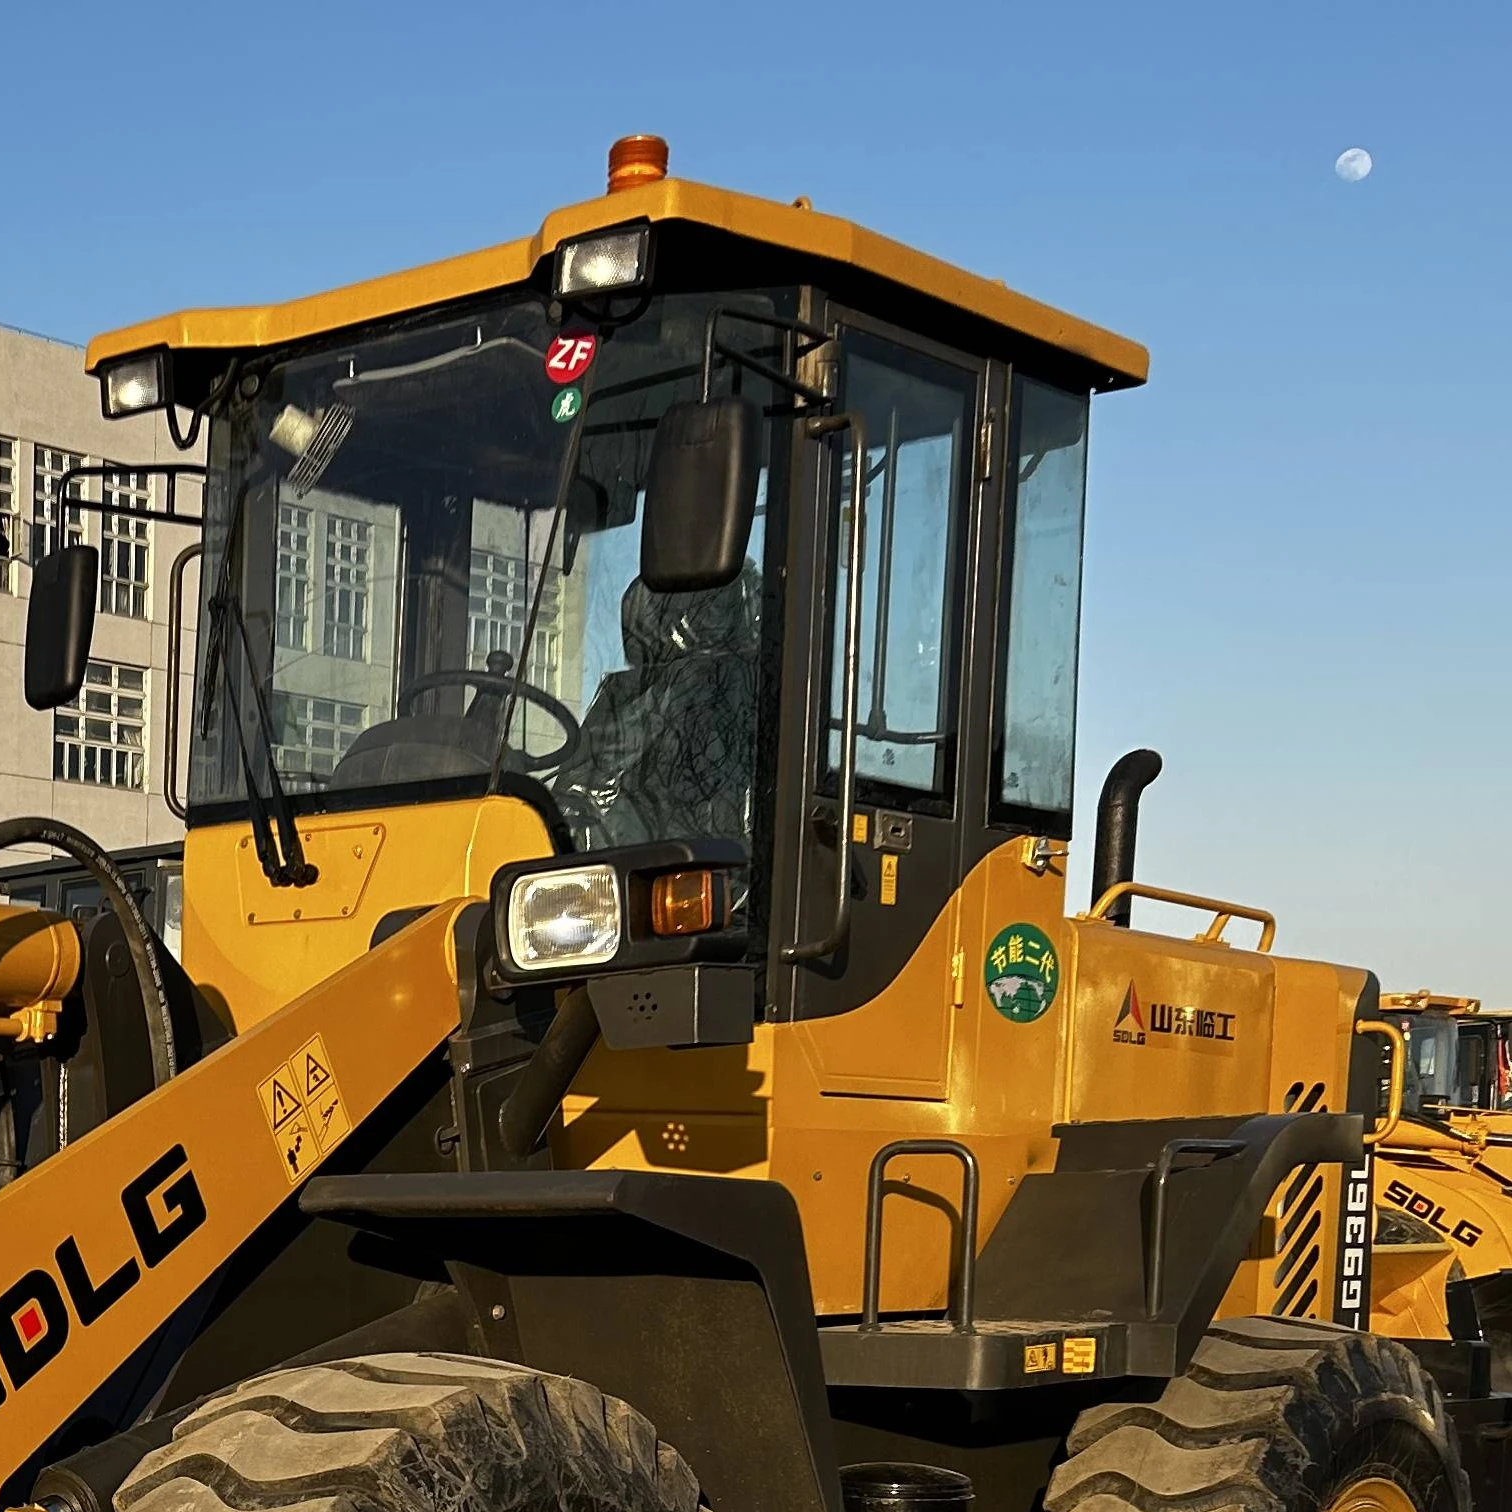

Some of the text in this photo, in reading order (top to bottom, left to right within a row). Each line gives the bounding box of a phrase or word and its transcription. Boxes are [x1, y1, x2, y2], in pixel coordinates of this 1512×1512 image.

[548, 338, 592, 370] ZF
[991, 934, 1055, 983] 节能二代
[1112, 1029, 1146, 1045] SDLG
[1150, 1003, 1236, 1042] 山东临工
[1383, 1179, 1483, 1248] SDLG
